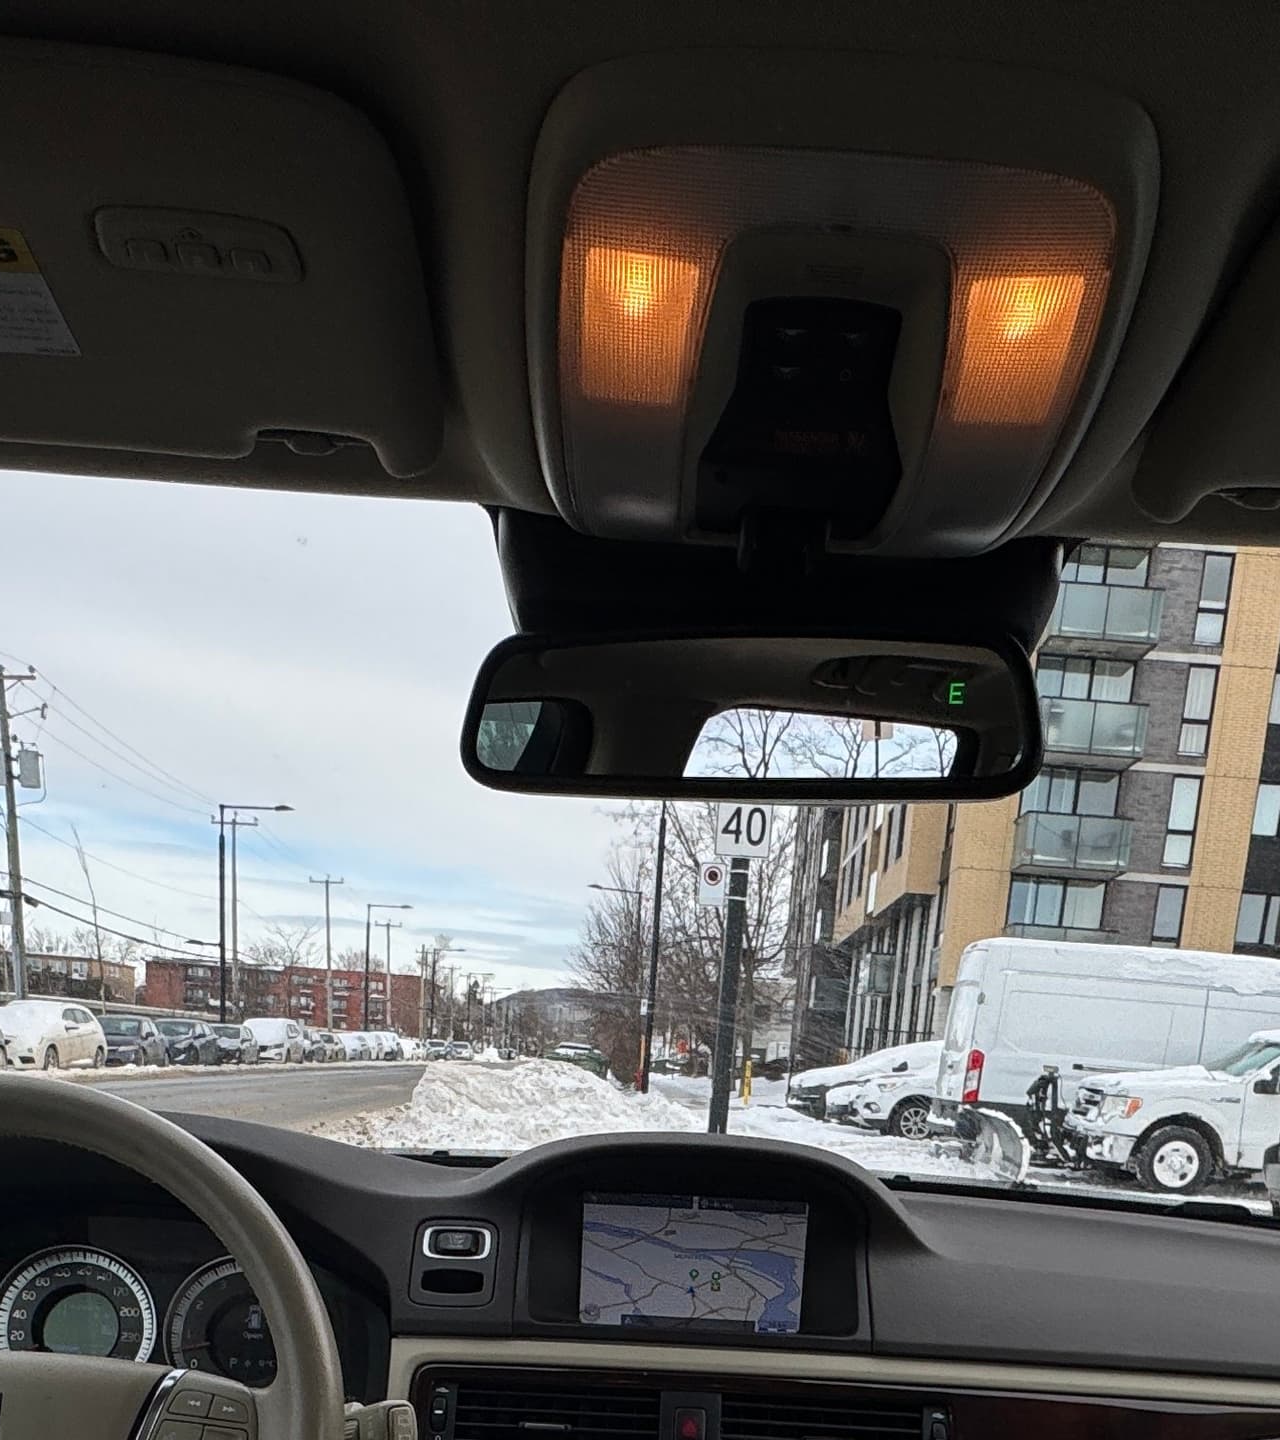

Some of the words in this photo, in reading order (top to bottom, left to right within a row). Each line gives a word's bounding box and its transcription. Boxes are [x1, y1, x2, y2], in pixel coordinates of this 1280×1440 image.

[947, 682, 967, 705] E
[720, 806, 768, 847] 40
[21, 1289, 37, 1301] 60
[195, 1299, 205, 1311] 2
[11, 1308, 28, 1320] 40
[119, 1306, 141, 1318] 200
[9, 1329, 25, 1342] 20
[120, 1331, 142, 1344] 230
[189, 1358, 199, 1370] 0
[228, 1356, 239, 1369] P
